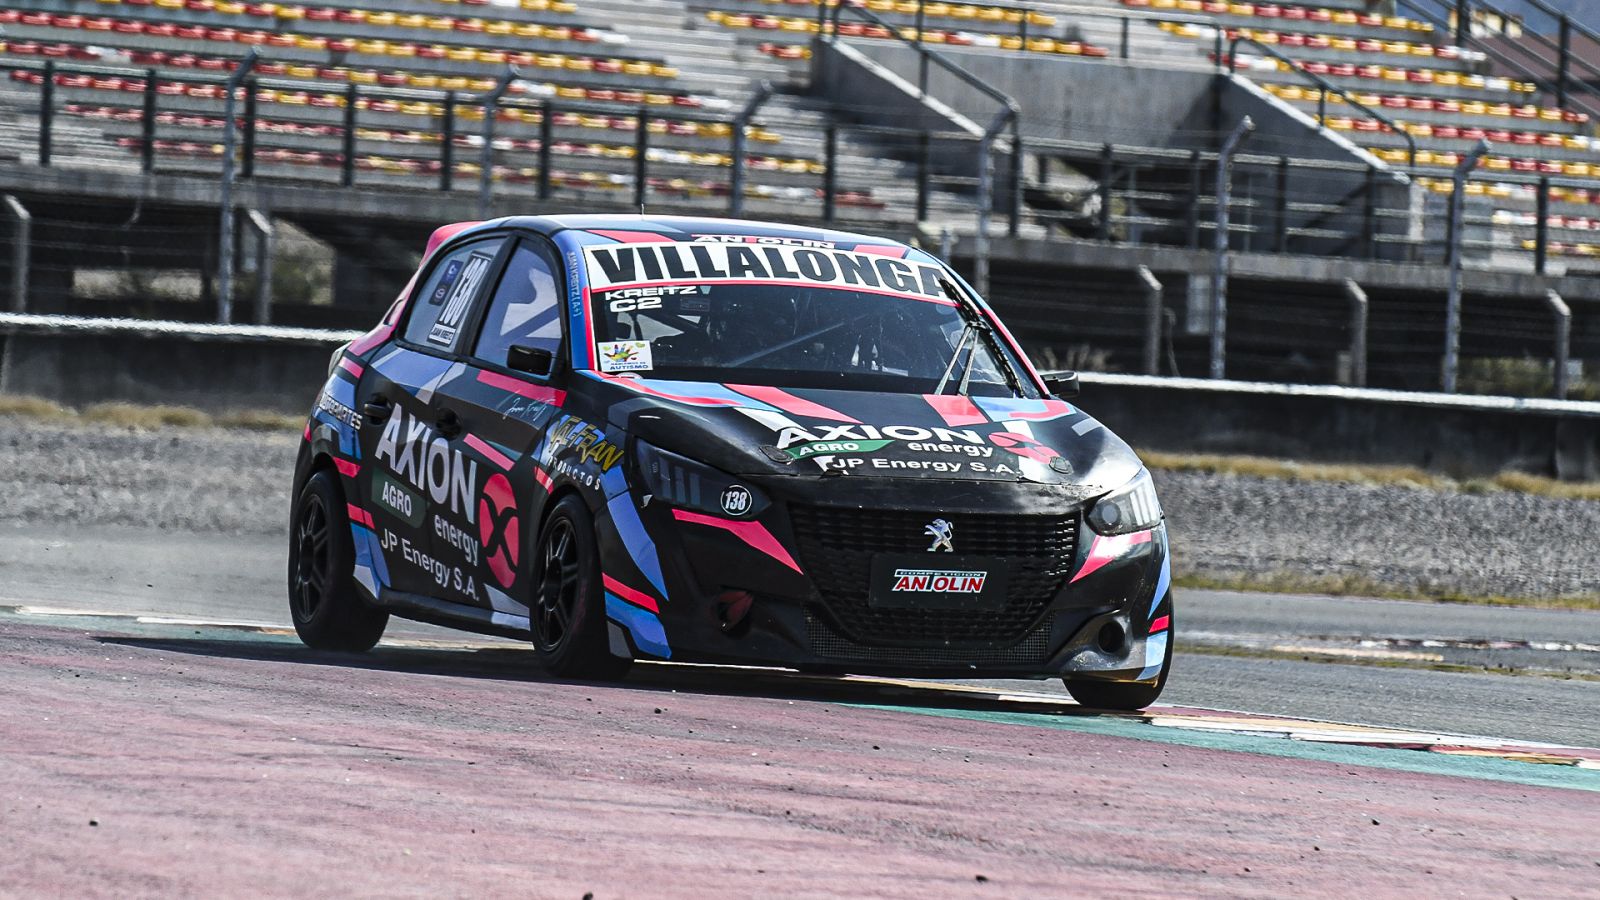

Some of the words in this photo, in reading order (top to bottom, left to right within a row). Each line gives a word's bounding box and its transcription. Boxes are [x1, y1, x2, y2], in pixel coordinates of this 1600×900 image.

[592, 245, 947, 297] VILLALONGA
[605, 285, 697, 300] KREITZ
[610, 296, 662, 313] C2
[776, 425, 985, 448] AXION
[800, 442, 860, 456] AGRO
[907, 440, 994, 457] energy
[375, 403, 478, 524] AXION
[833, 458, 863, 469] JP
[874, 458, 962, 473] Energy
[971, 462, 1022, 474] S.A.
[382, 481, 412, 518] AGRO
[725, 491, 747, 511] 138
[434, 514, 479, 567] energy
[381, 529, 398, 552] JP
[401, 537, 450, 588] Energy
[454, 567, 480, 601] S.A.
[894, 575, 985, 592] ANTOLIN
